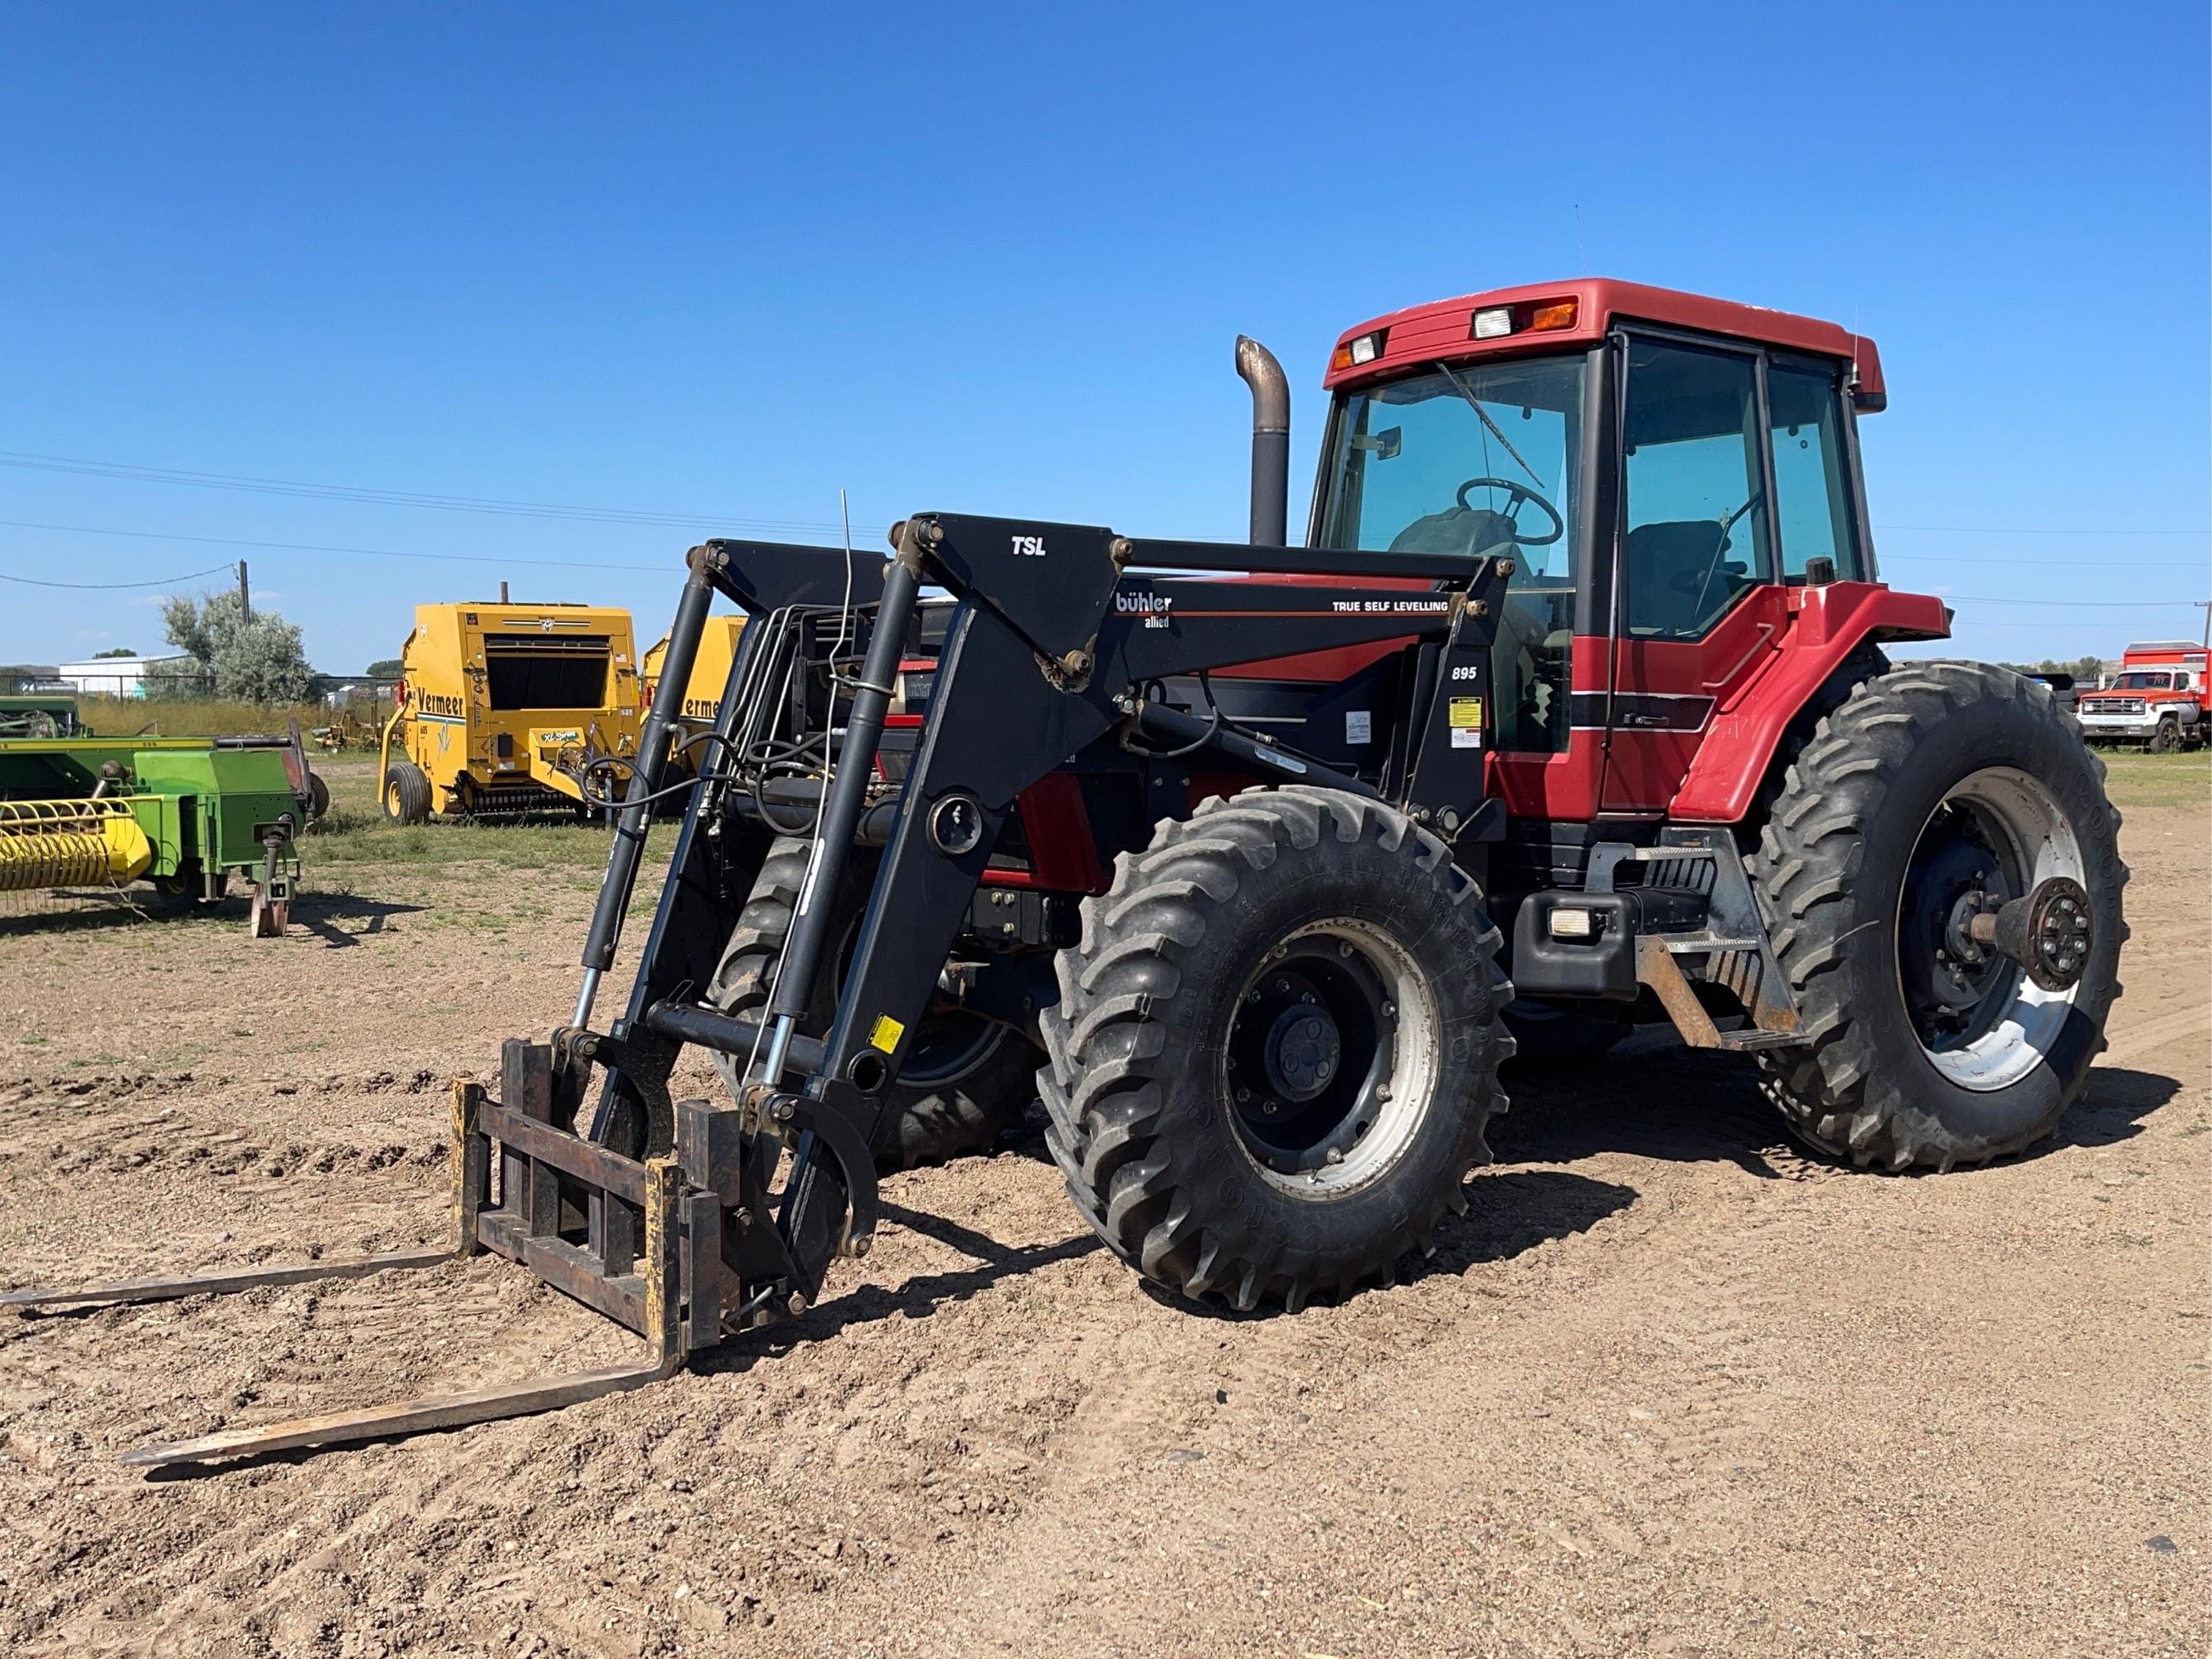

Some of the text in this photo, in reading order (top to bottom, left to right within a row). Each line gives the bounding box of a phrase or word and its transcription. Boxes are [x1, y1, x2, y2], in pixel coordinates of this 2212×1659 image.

[1012, 536, 1046, 556] TSL
[1116, 592, 1172, 612] bühler
[1333, 601, 1448, 611] TRUE SELF LEVELLING
[1145, 615, 1169, 628] allied
[1451, 666, 1477, 680] 895
[417, 687, 463, 717] Vermeer
